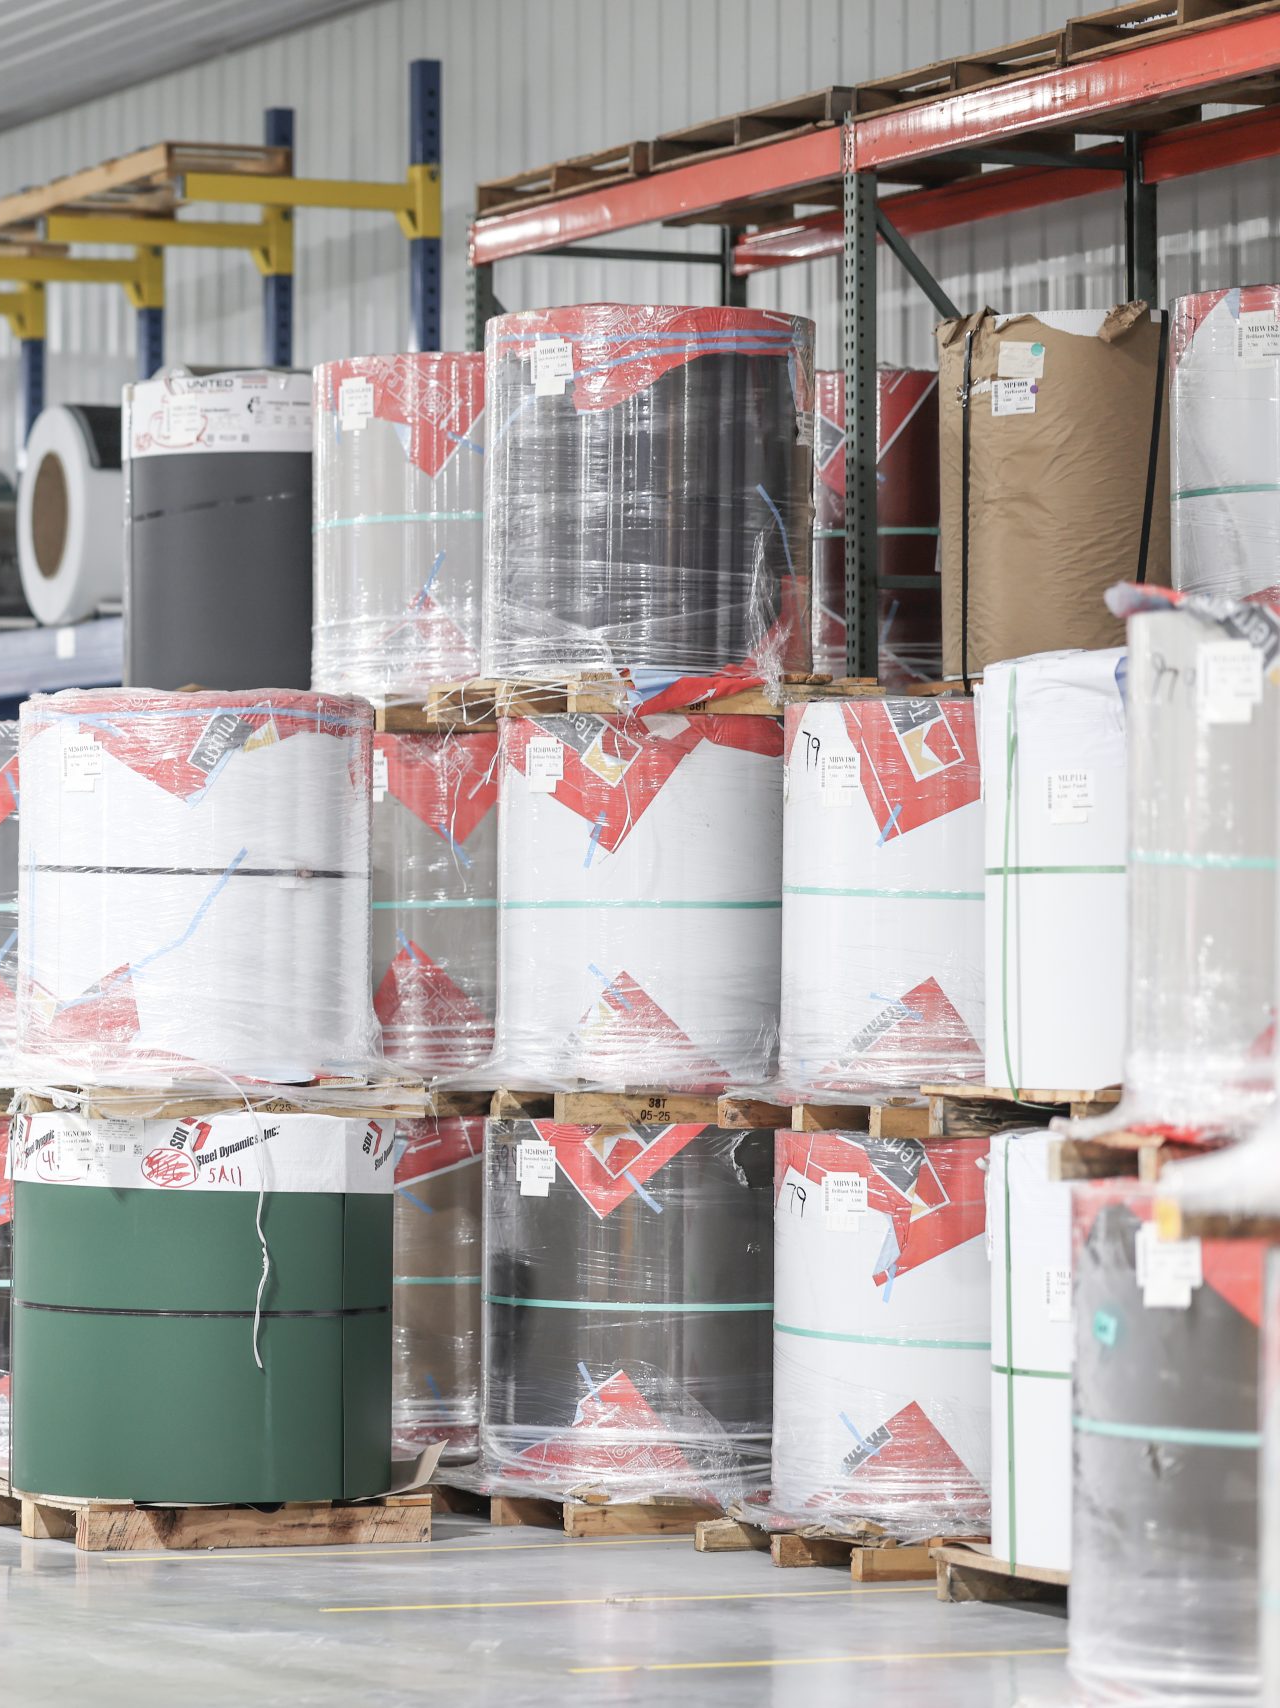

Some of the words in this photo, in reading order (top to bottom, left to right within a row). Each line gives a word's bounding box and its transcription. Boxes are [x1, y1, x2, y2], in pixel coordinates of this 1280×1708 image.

[187, 378, 234, 389] UNITED
[802, 731, 820, 773] 79
[649, 1098, 667, 1108] 38T
[641, 1110, 670, 1121] 05-25
[170, 1127, 189, 1150] SDI
[362, 1131, 374, 1154] SDI
[196, 1149, 218, 1167] Steel
[786, 1182, 807, 1219] 79
